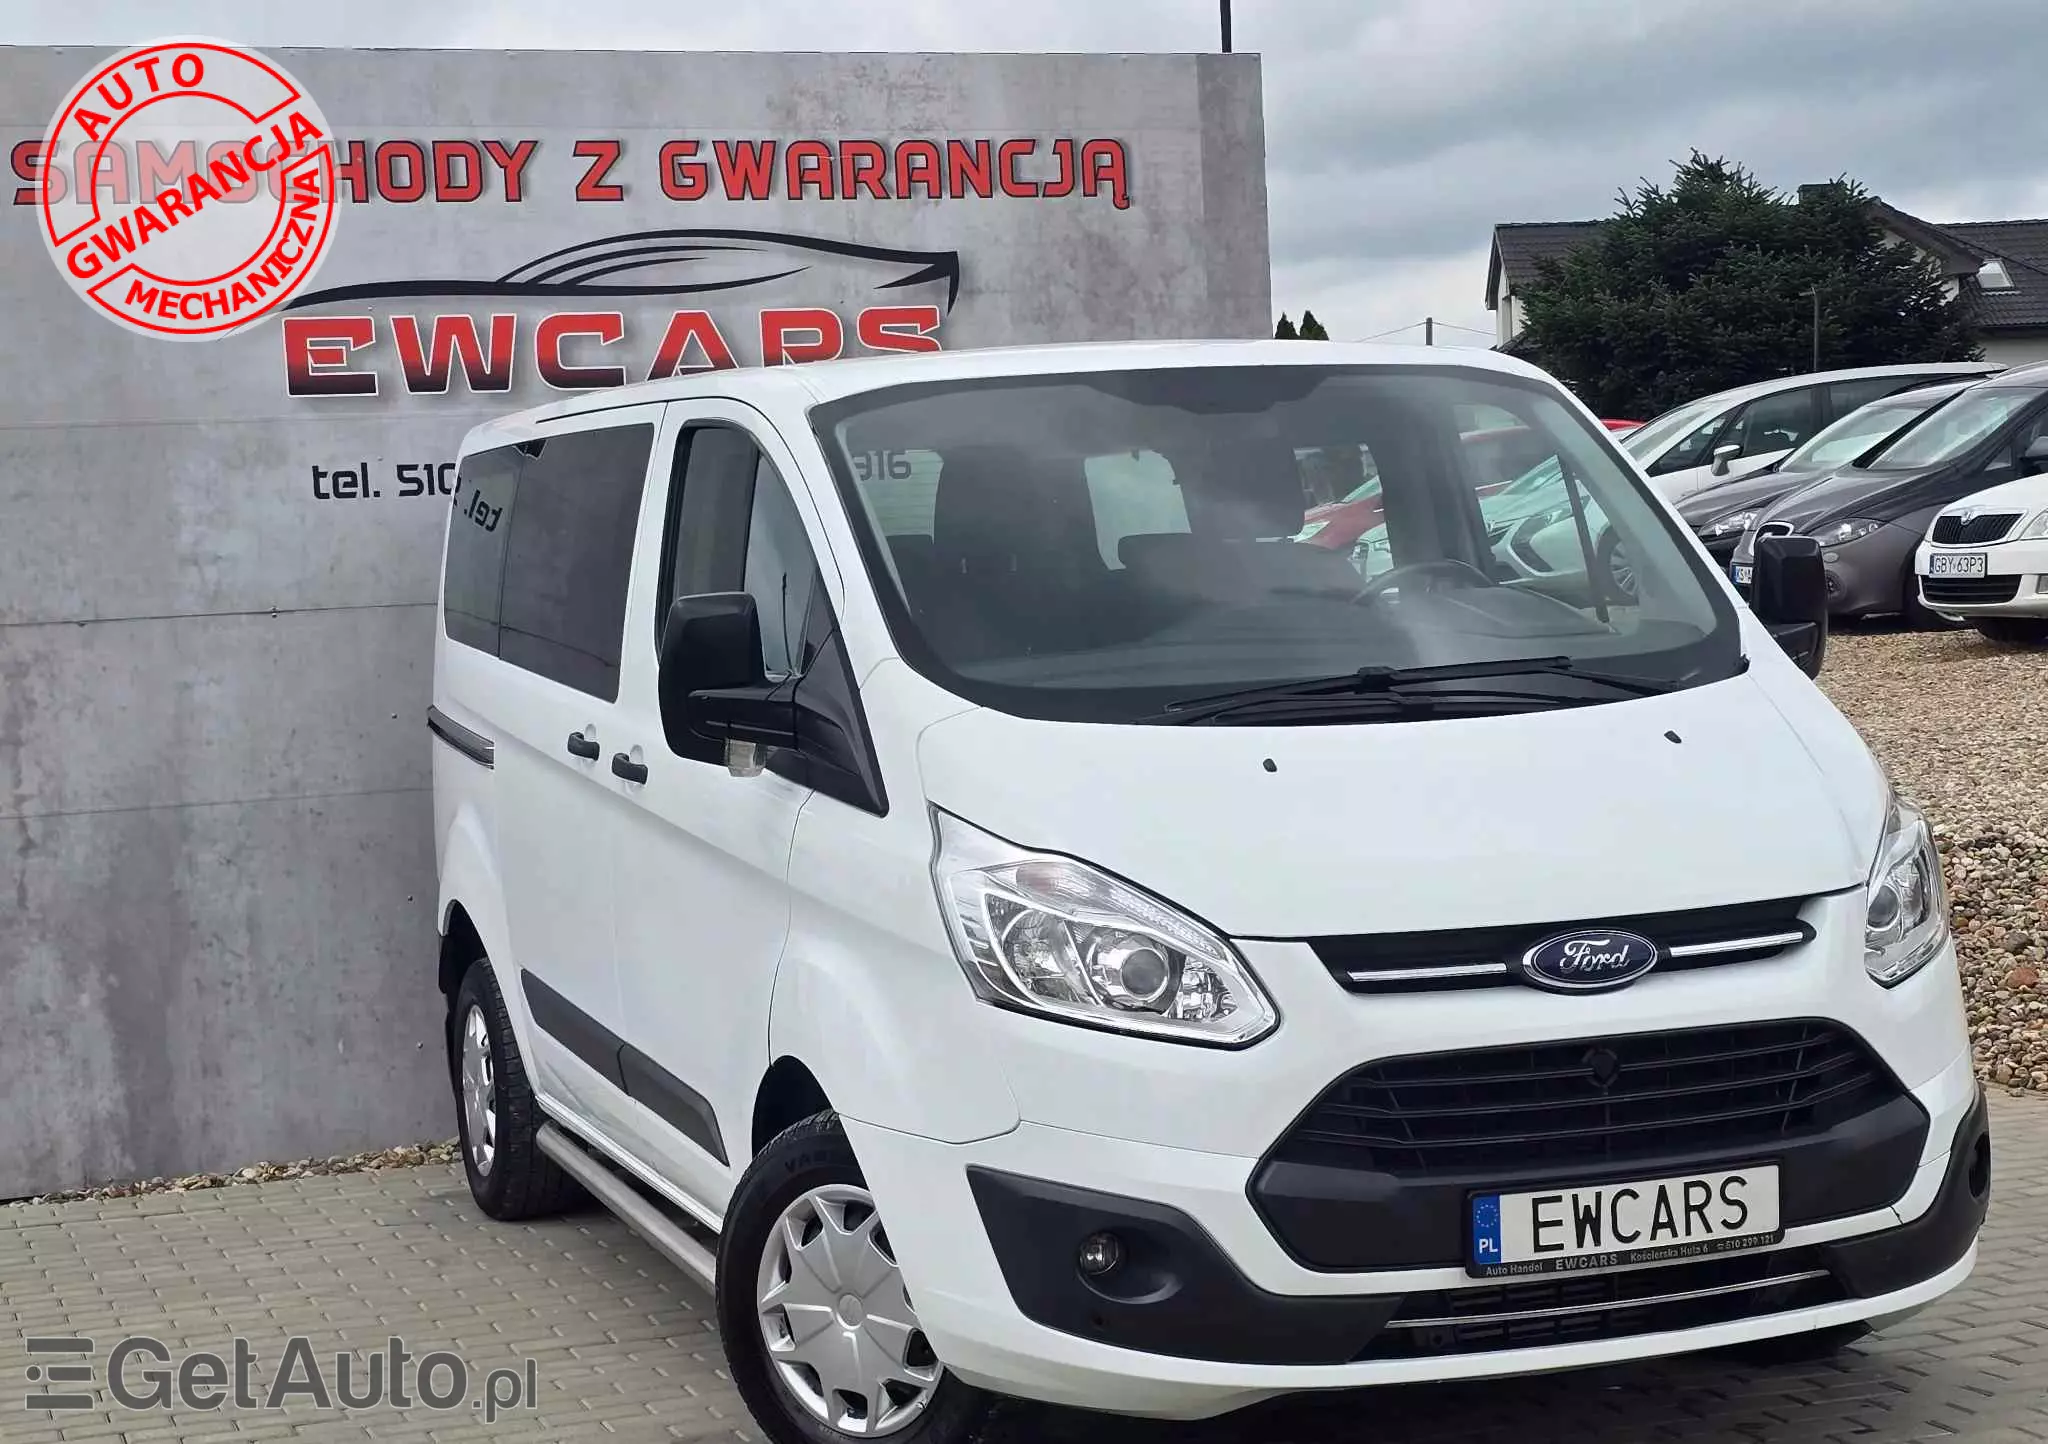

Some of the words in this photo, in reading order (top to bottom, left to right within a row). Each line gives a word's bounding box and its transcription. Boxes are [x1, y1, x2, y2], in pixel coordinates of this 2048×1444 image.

[11, 139, 536, 205] SAMOCHODY
[573, 140, 624, 201] Z
[658, 138, 1130, 210] GWARANCJĄ
[312, 462, 380, 499] tel.
[1559, 939, 1631, 974] Ford
[1478, 1238, 1499, 1253] PL
[1532, 1176, 1748, 1253] EWCARS
[1486, 1265, 1508, 1276] Auto
[1510, 1261, 1543, 1274] Handel
[1555, 1253, 1618, 1270] EWCARS
